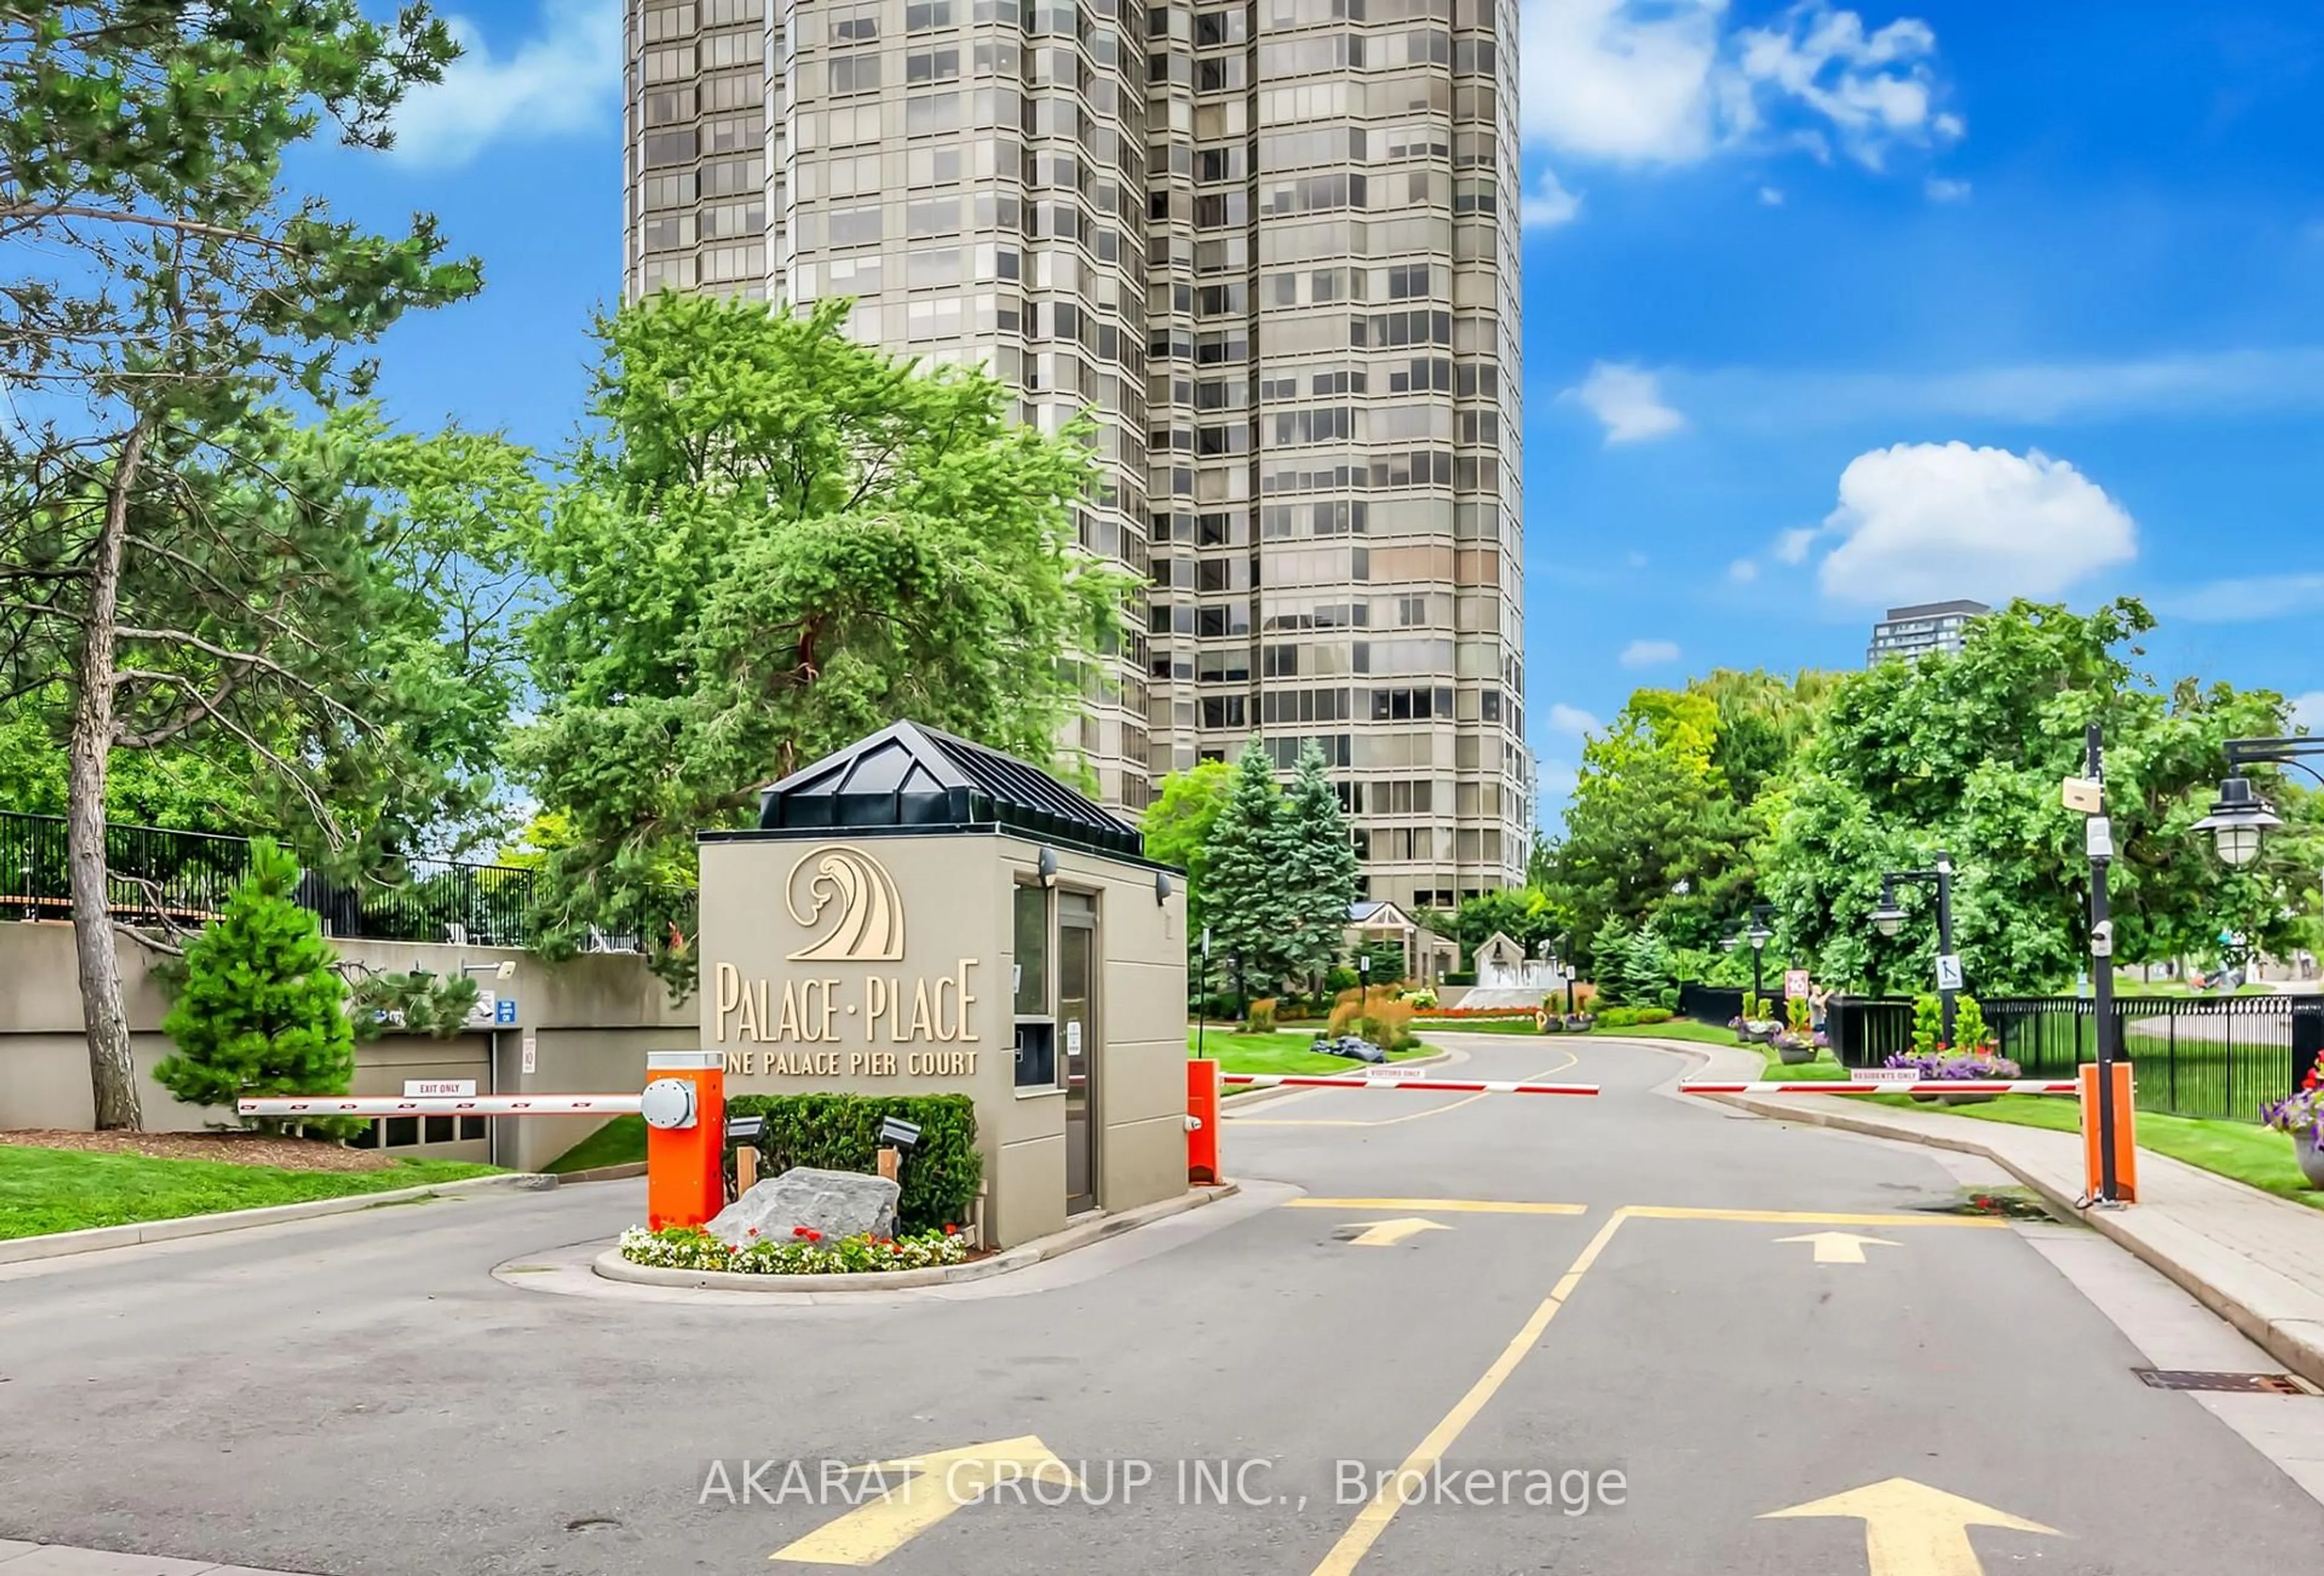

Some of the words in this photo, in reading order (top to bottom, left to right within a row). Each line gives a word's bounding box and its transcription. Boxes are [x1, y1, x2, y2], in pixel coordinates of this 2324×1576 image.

[715, 961, 841, 1042] PALACE
[865, 958, 980, 1042] PLACE
[764, 1051, 841, 1075] PALACE
[850, 1051, 898, 1075] PIER
[908, 1051, 978, 1075] COURT
[420, 1085, 438, 1093] EXIT
[440, 1084, 460, 1093] ONLY
